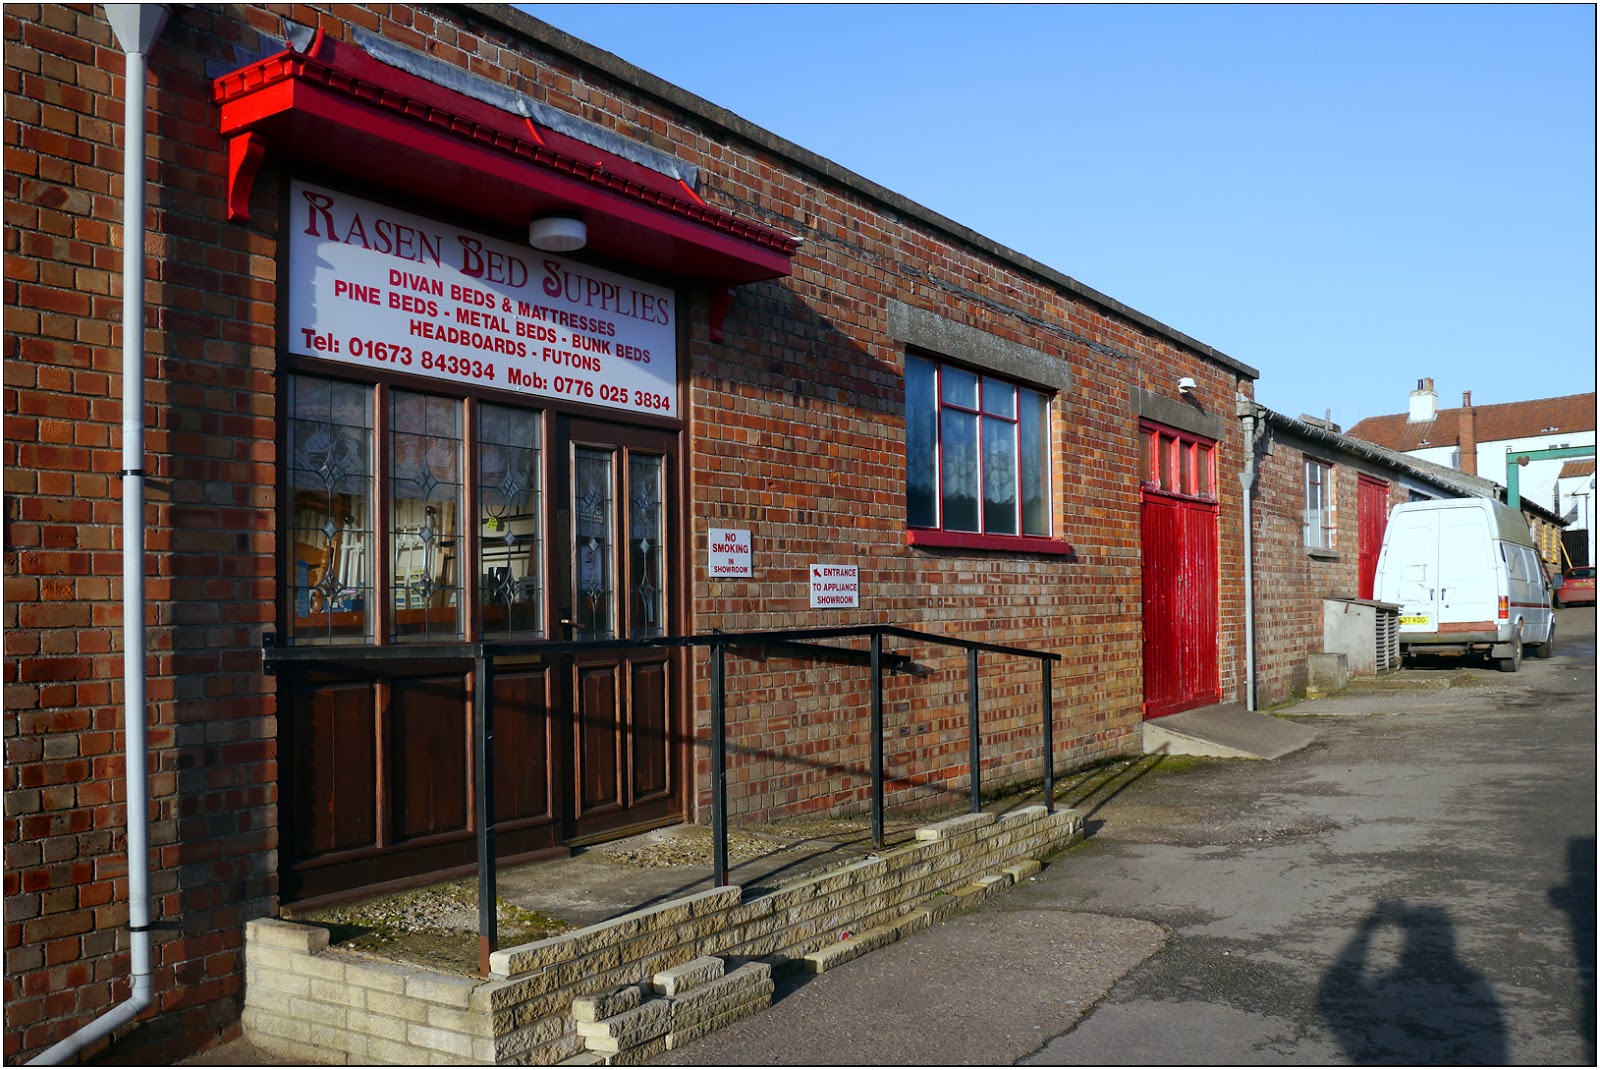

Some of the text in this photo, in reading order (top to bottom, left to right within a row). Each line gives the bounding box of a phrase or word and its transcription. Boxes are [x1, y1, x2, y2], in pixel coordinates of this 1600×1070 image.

[302, 190, 670, 327] RASEN BED SUPPLIES
[389, 268, 616, 337] DIVAN BEDS & MATTRESSES
[334, 279, 381, 306] PINE
[388, 291, 438, 318] BEDS
[455, 307, 510, 334] METAL
[515, 321, 557, 344] BEDS
[571, 334, 611, 356] BUNK
[615, 344, 651, 365] BEDS
[409, 318, 527, 358] HEADBOARDS
[542, 347, 602, 373] FUTONS
[301, 328, 671, 412] Tel: 01673 843934 Mob: 0776 025 3834
[725, 533, 736, 542] NO
[712, 543, 749, 554] SMOKING
[713, 565, 748, 573] SHOWROOM
[823, 568, 857, 577] ENTRANCE
[813, 583, 858, 592] TO APPLIANCE
[817, 596, 854, 604] SHOWROOM
